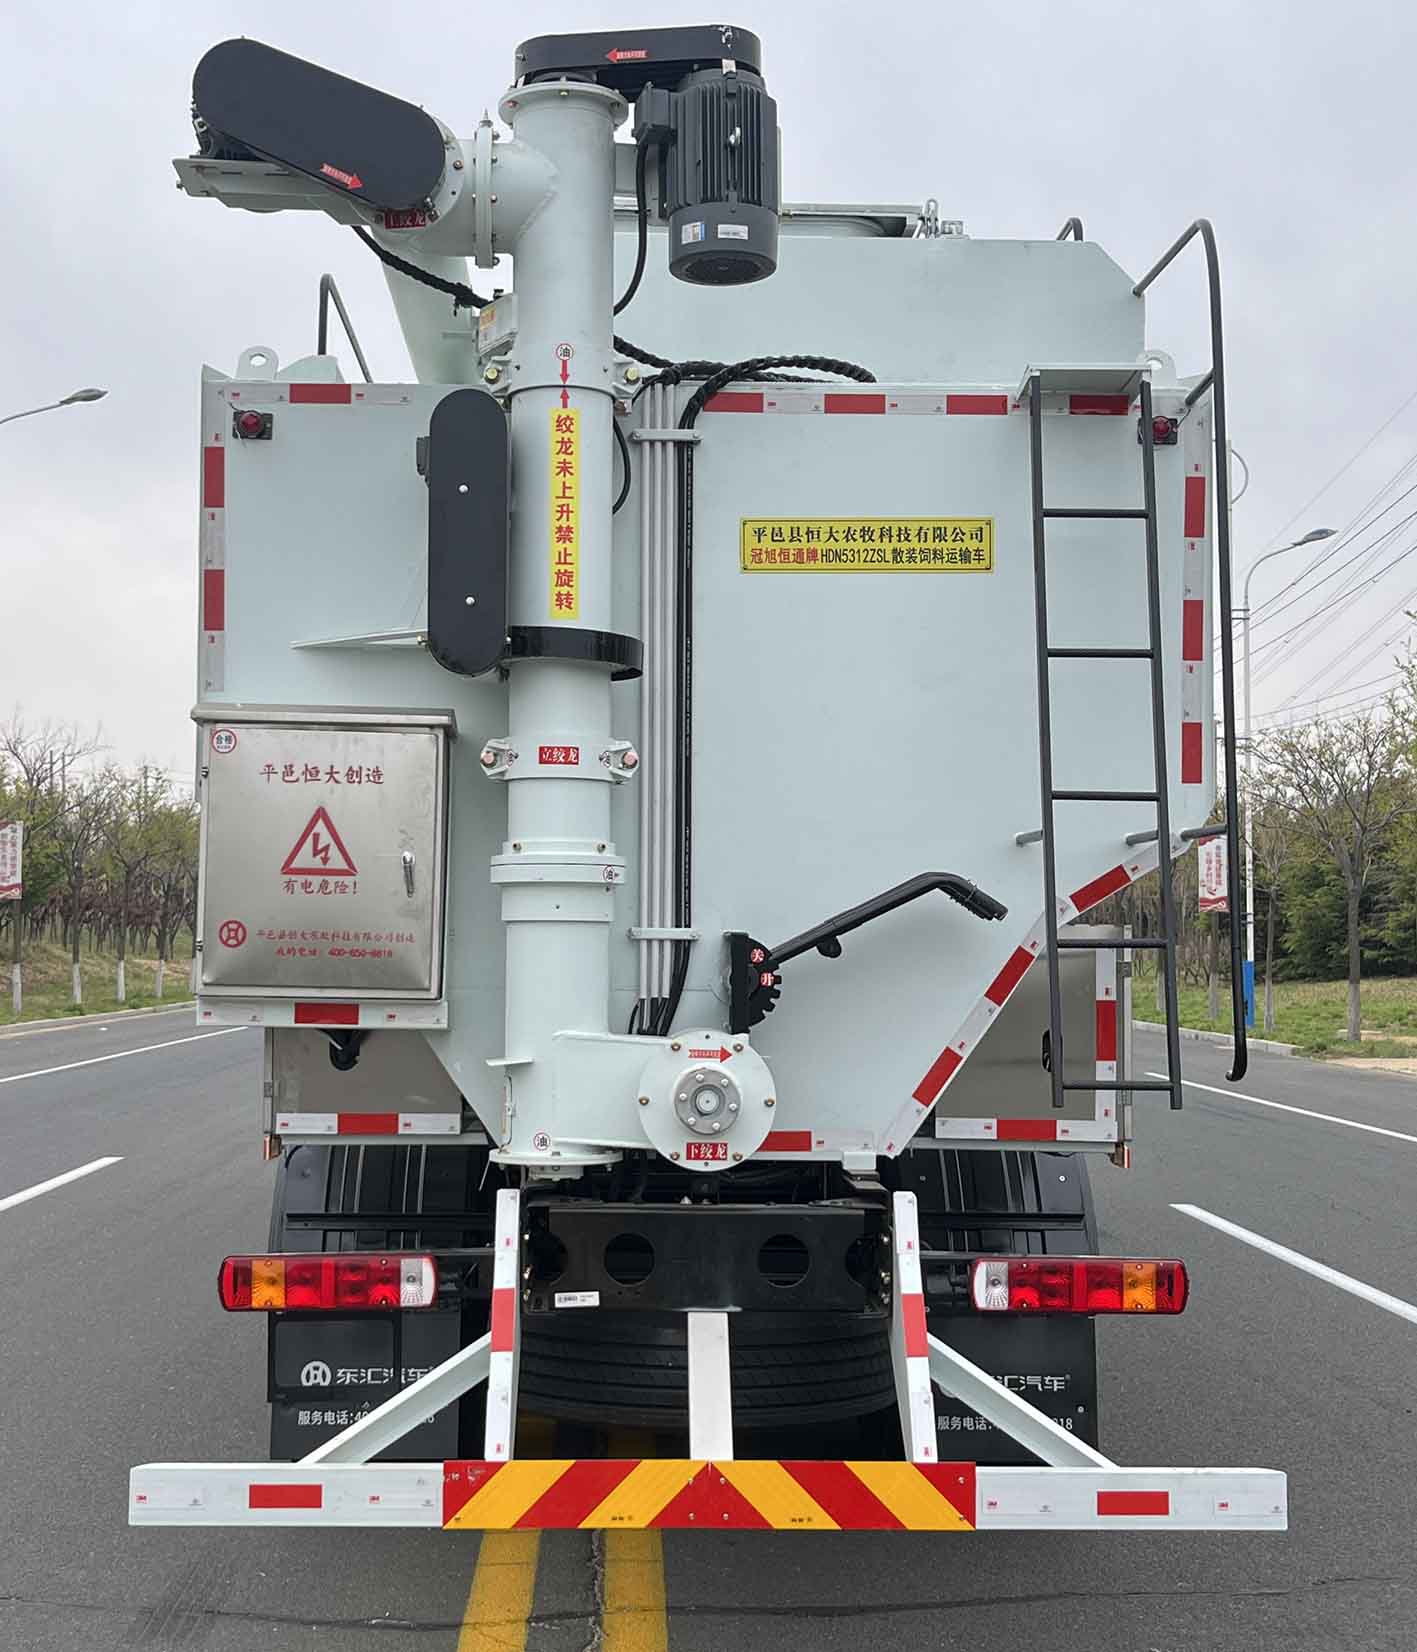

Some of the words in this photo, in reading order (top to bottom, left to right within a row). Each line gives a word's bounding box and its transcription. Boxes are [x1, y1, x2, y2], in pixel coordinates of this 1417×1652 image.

[555, 414, 575, 611] 绞龙未上升禁止旋转
[751, 526, 985, 544] 平邑县恒大农牧科技有限公司
[259, 763, 385, 785] 平邑恒大创造
[751, 948, 765, 962] 关
[690, 1142, 727, 1160] 下绞龙
